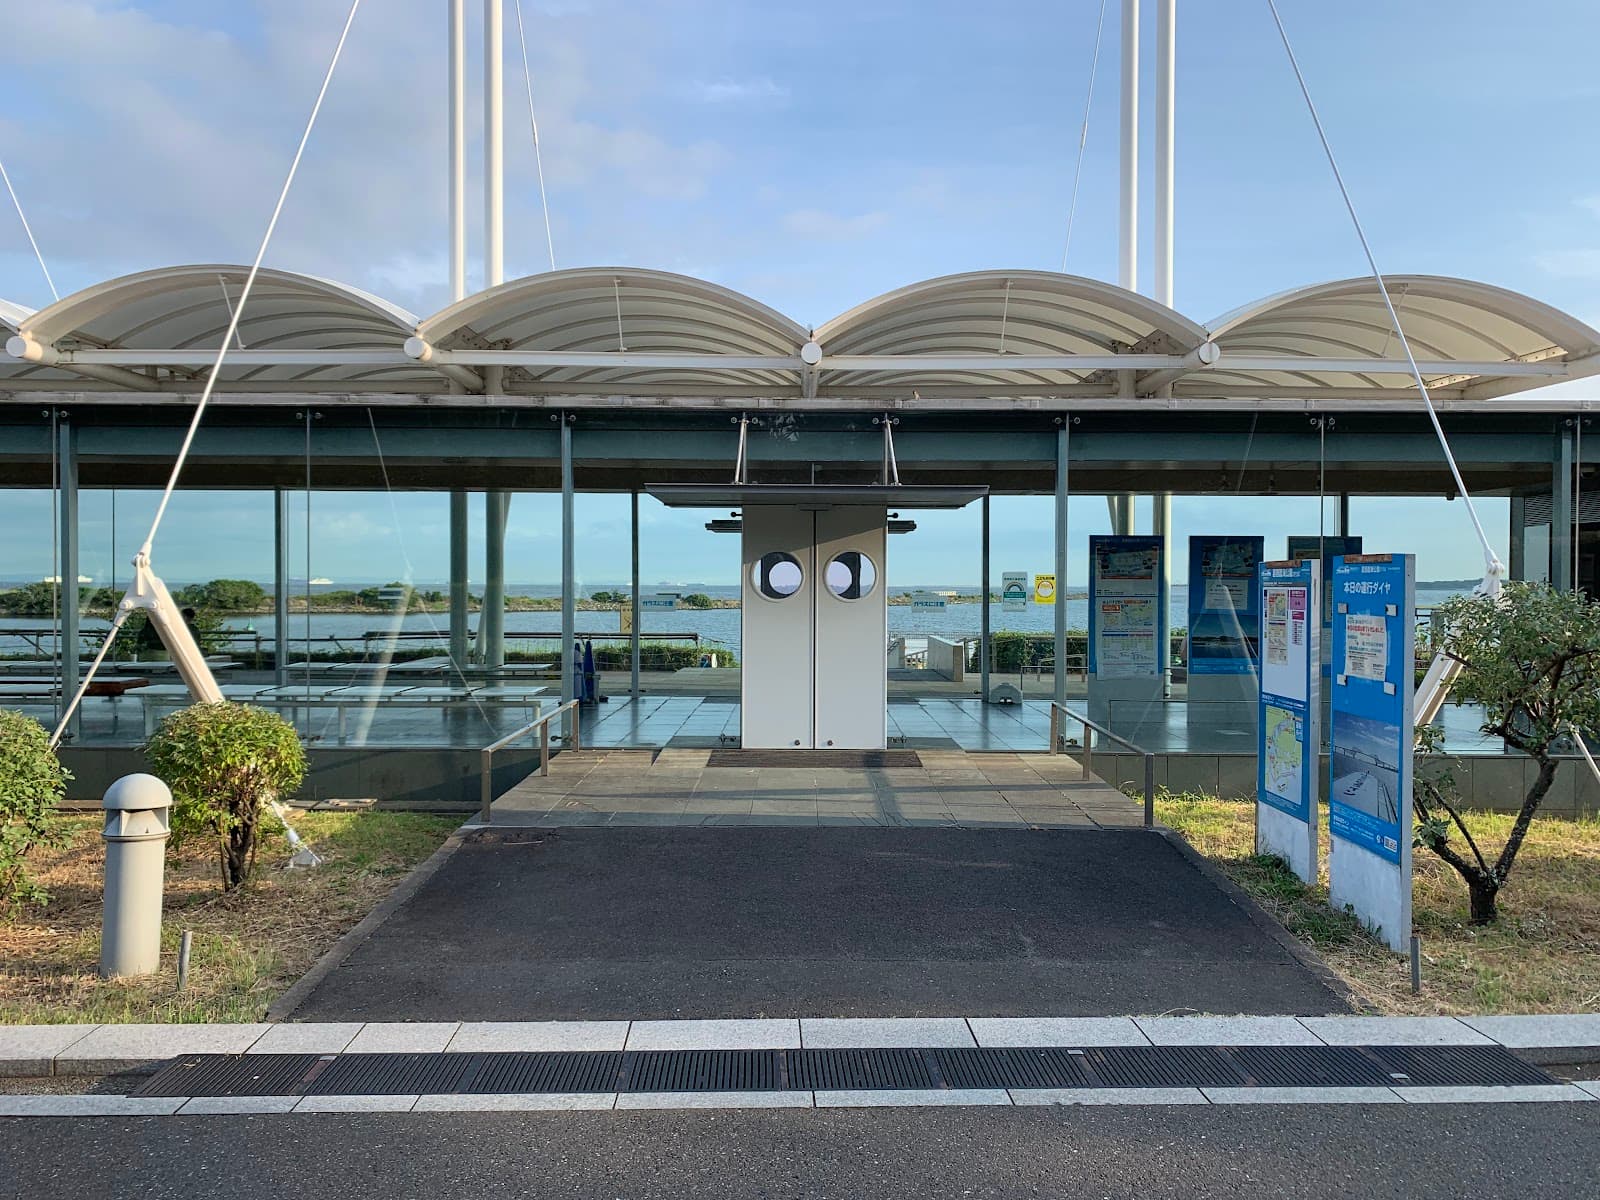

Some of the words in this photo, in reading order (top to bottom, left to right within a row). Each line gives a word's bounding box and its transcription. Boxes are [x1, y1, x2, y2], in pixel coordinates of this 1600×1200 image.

[1343, 581, 1391, 595] 本日の運行ダイヤ
